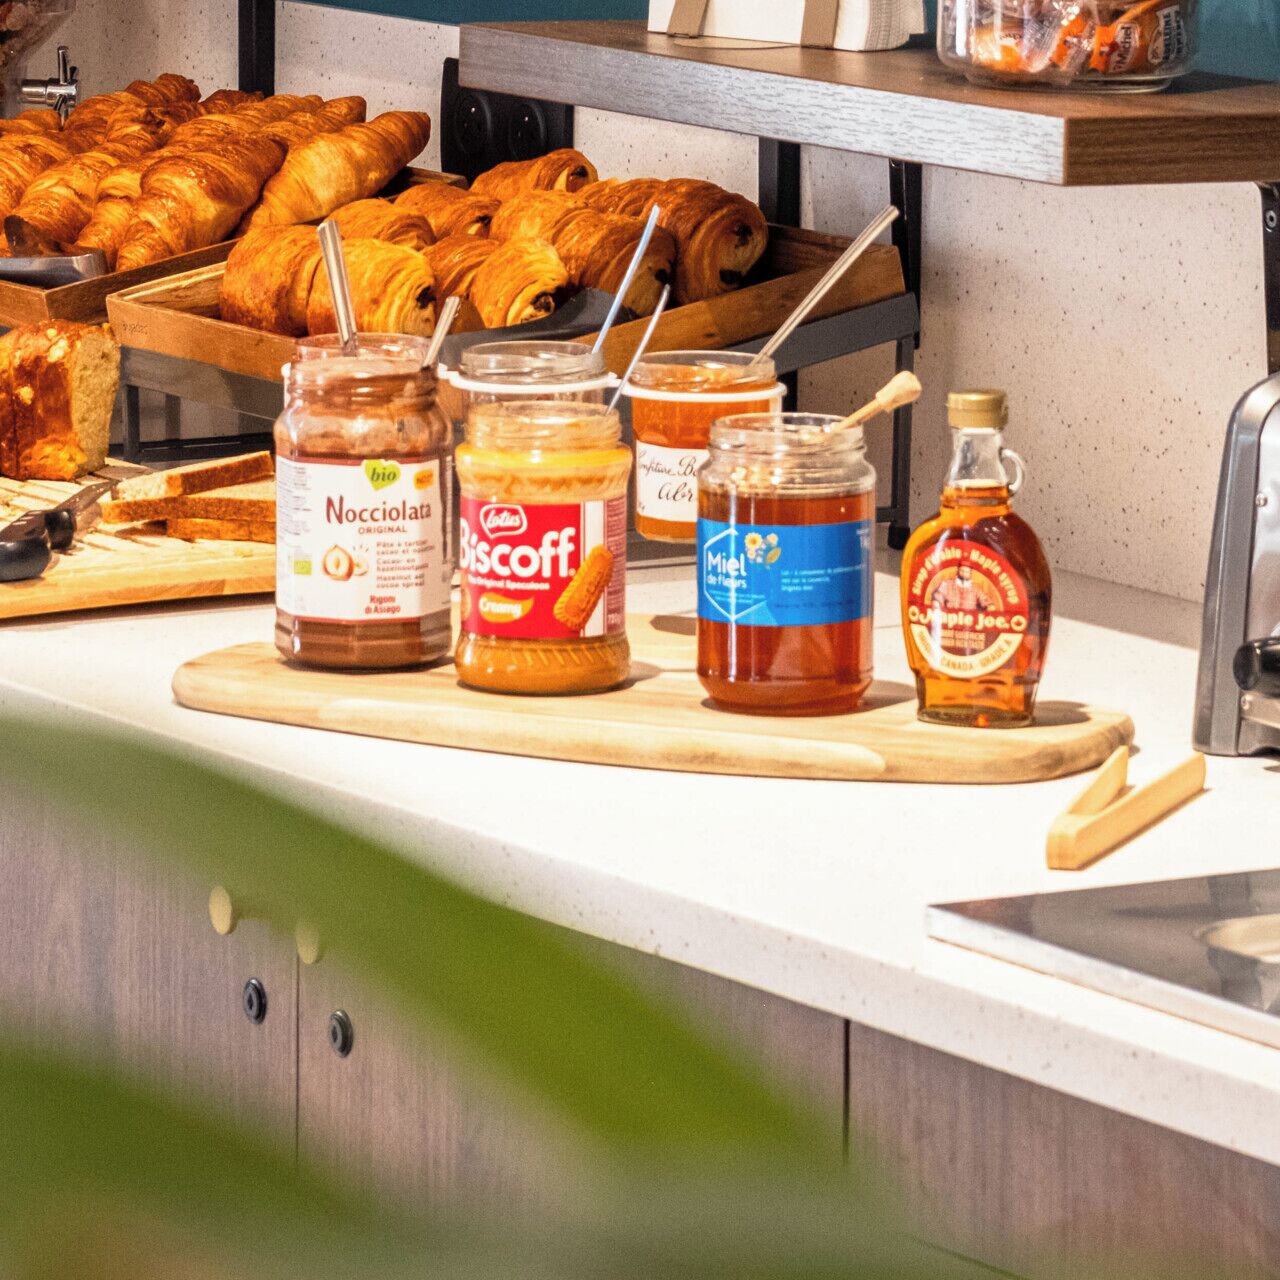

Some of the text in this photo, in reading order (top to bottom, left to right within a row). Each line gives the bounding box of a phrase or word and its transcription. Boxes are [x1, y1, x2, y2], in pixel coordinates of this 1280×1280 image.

[370, 467, 398, 482] bio
[325, 494, 433, 525] Nocciolata
[486, 509, 522, 529] Lotus
[357, 525, 408, 535] ORIGINAL
[460, 517, 576, 578] Biscoff
[707, 550, 747, 577] Miel
[707, 574, 717, 585] de
[478, 597, 523, 619] Creamy
